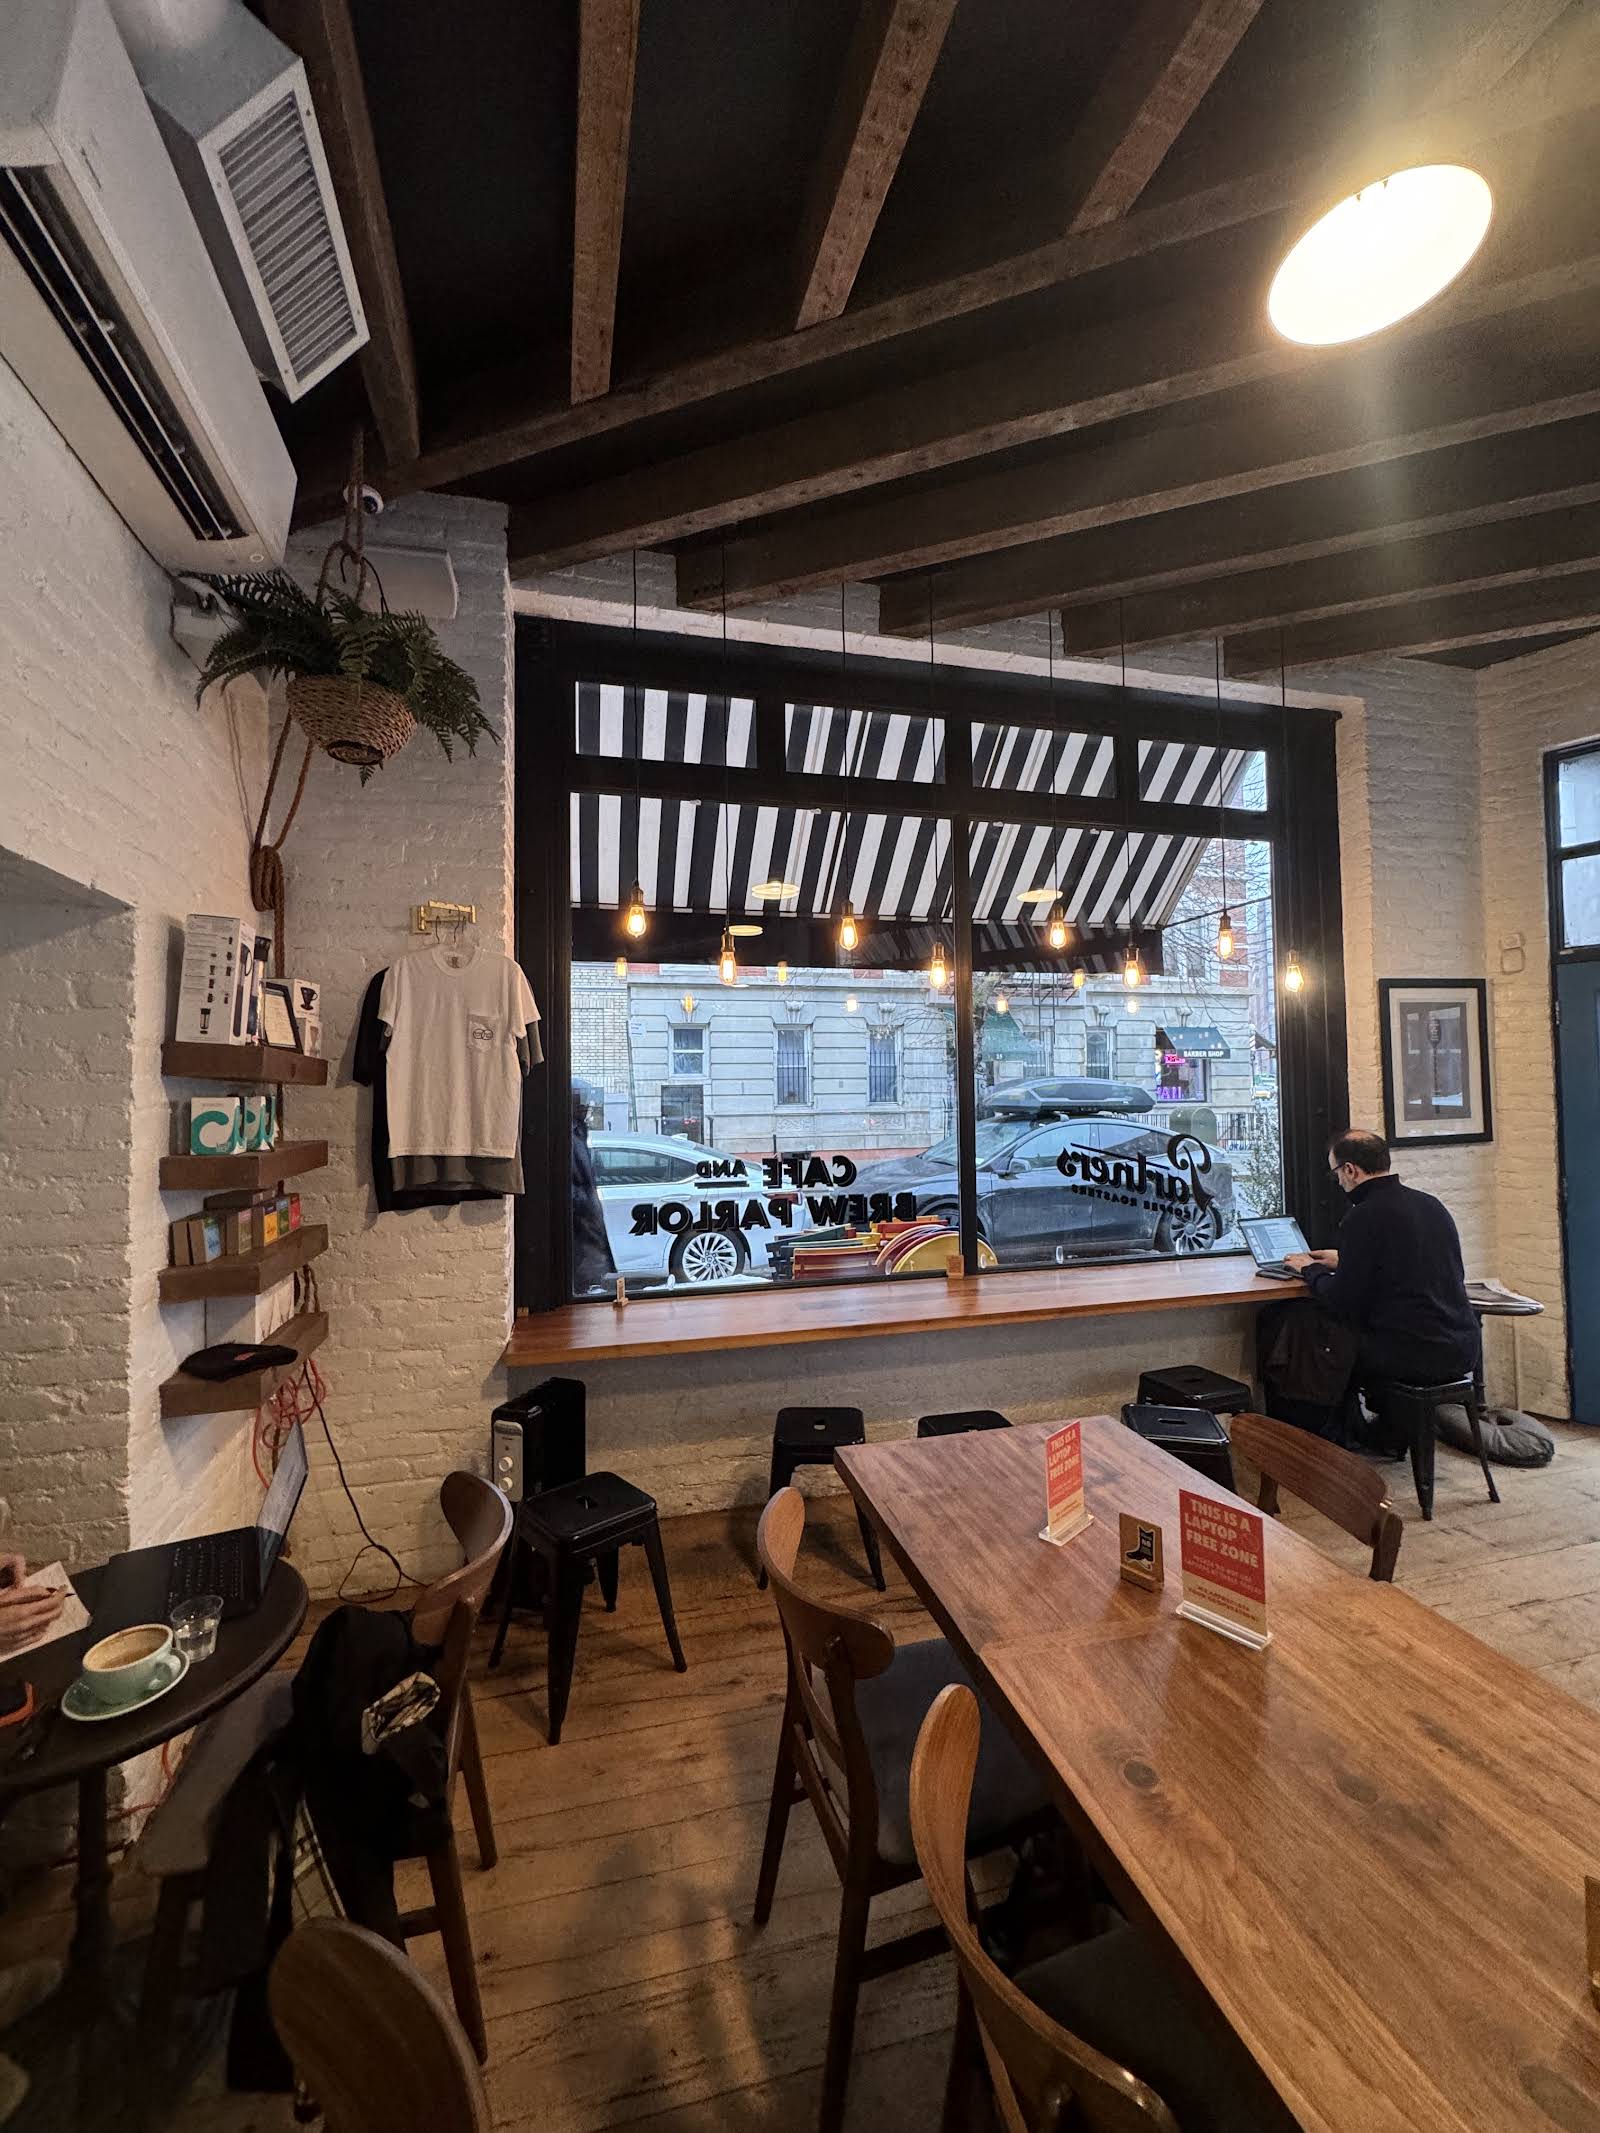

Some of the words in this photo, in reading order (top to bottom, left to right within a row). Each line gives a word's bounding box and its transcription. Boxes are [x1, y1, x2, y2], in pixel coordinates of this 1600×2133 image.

[1183, 1050, 1207, 1058] BARBER
[1208, 1050, 1224, 1058] SHOP
[1184, 1512, 1238, 1541] LAPTOP
[1190, 1499, 1221, 1521] THIS
[1223, 1511, 1238, 1527] IS
[1240, 1518, 1251, 1533] A
[1185, 1529, 1218, 1552] FREE
[1220, 1542, 1260, 1568] ZONE
